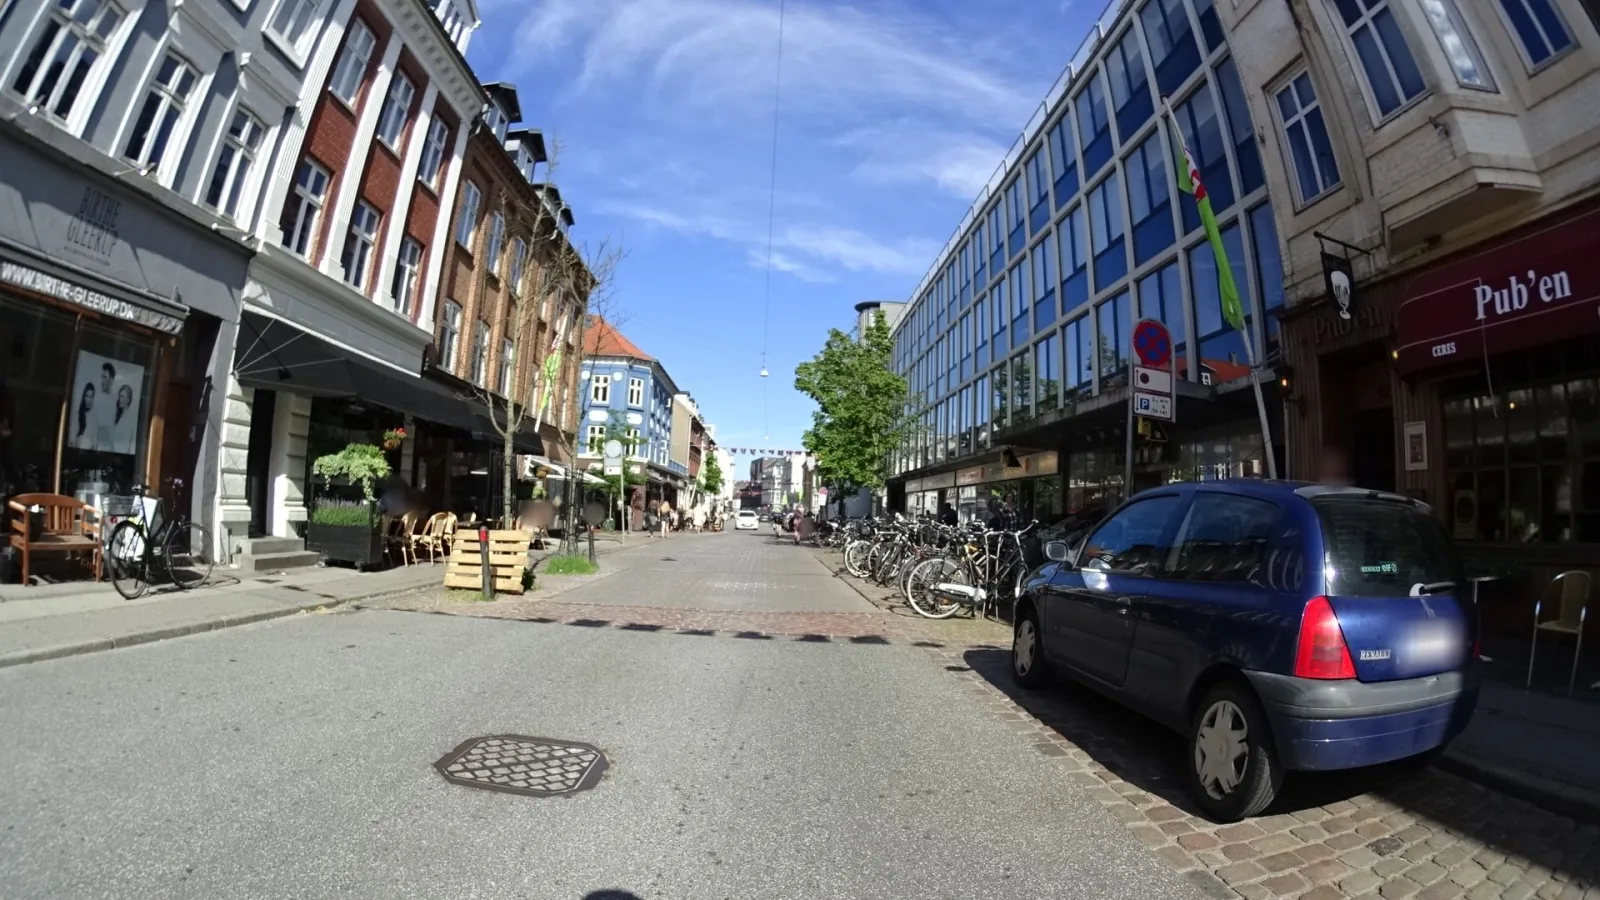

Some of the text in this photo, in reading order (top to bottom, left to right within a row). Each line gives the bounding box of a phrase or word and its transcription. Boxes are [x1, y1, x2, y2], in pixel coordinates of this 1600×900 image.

[79, 187, 122, 228] BIRTHE
[67, 214, 119, 257] GLEERUP
[1474, 269, 1572, 321] Pub'en
[1432, 342, 1457, 358] CERES
[1360, 650, 1391, 660] RENAULT
